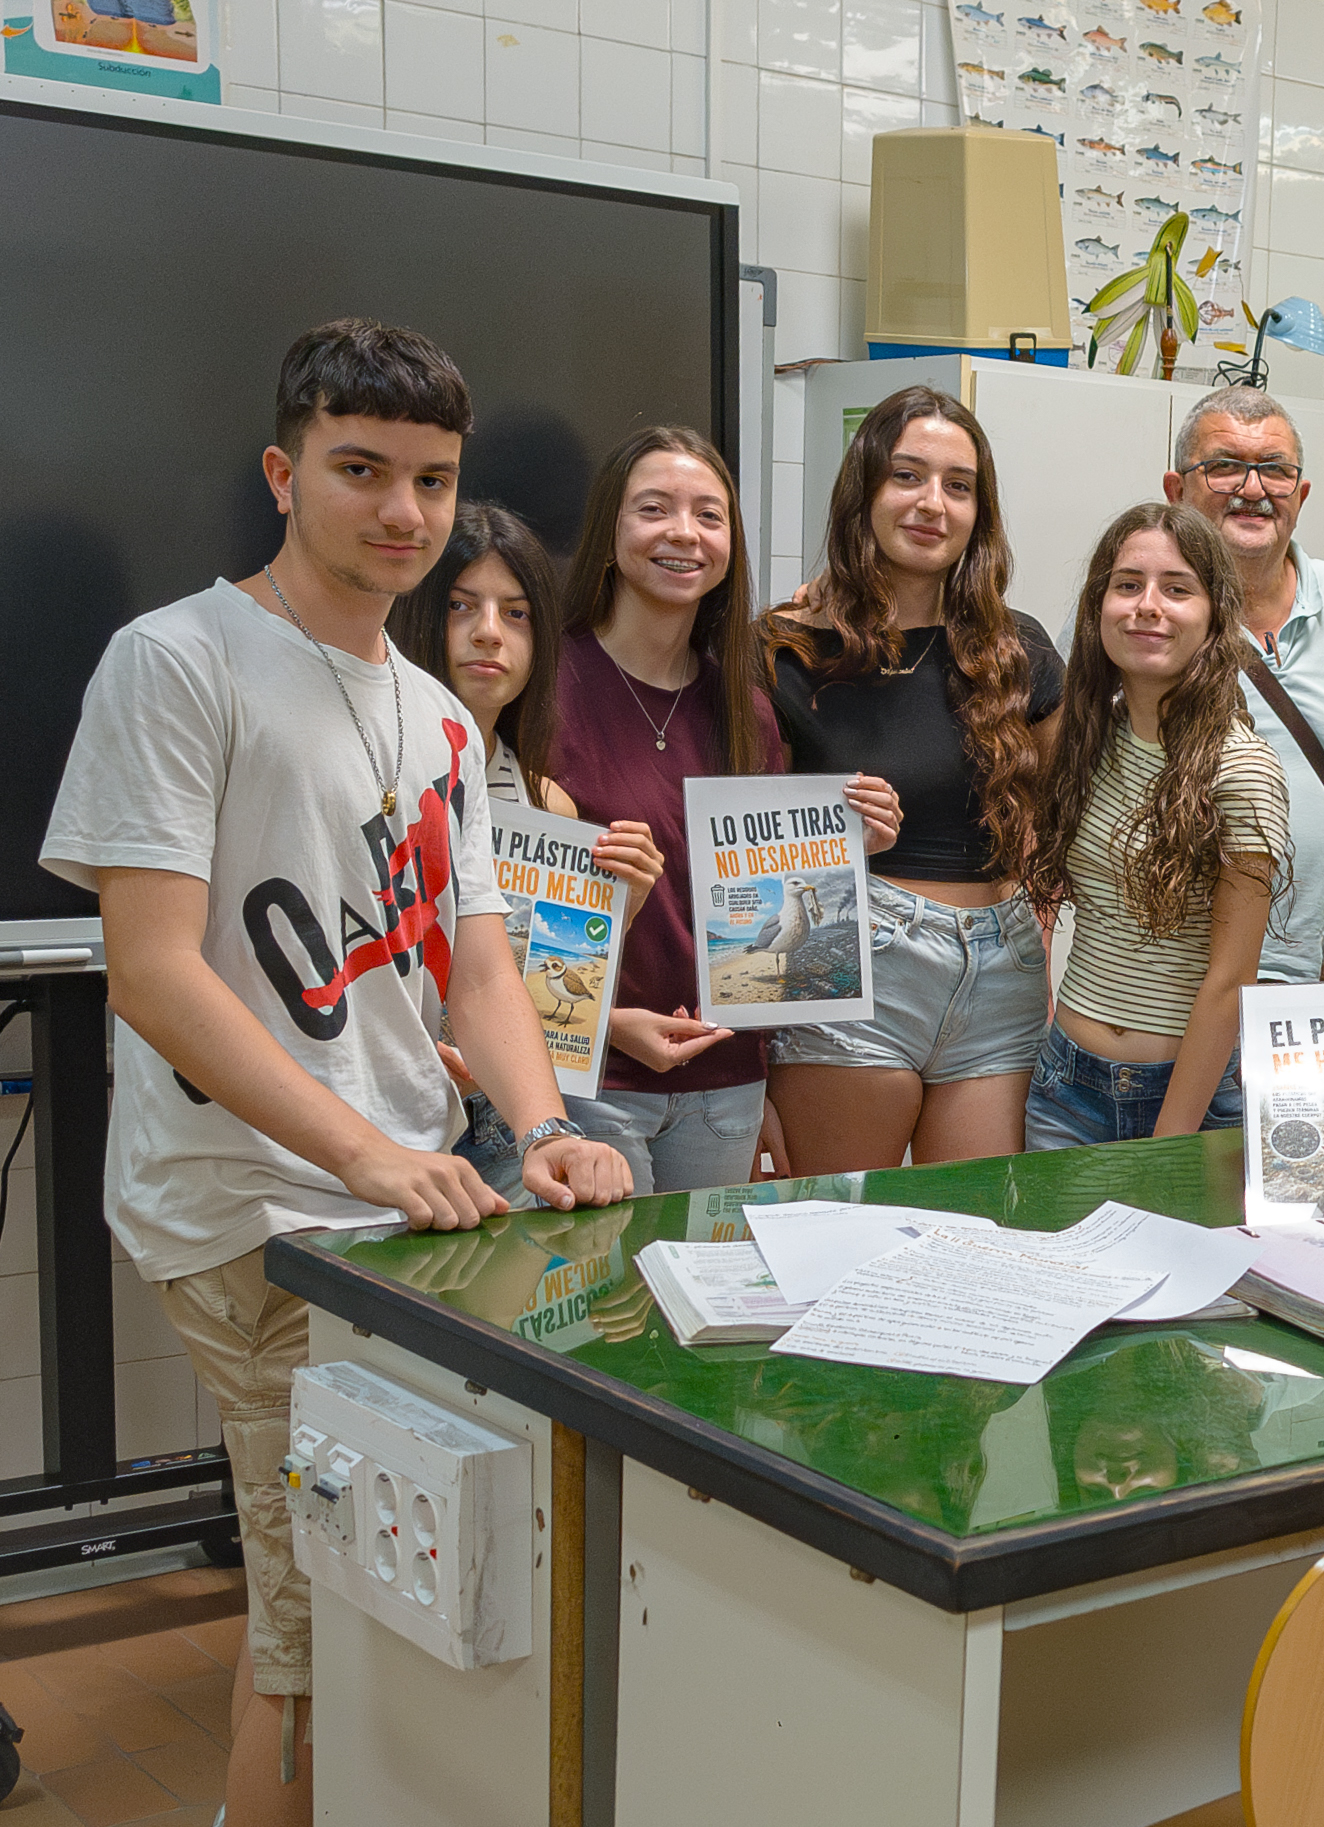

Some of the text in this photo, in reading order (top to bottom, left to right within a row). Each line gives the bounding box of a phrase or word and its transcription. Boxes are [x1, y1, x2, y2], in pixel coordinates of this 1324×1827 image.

[98, 62, 151, 77] Subducción
[710, 804, 847, 847] LO QUE TIRAS
[714, 837, 851, 879] NO DESAPARECE
[546, 870, 614, 912] MEJOR
[560, 1032, 568, 1042] LA
[1270, 1020, 1302, 1048] EL
[555, 1042, 591, 1056] NATURALEZA
